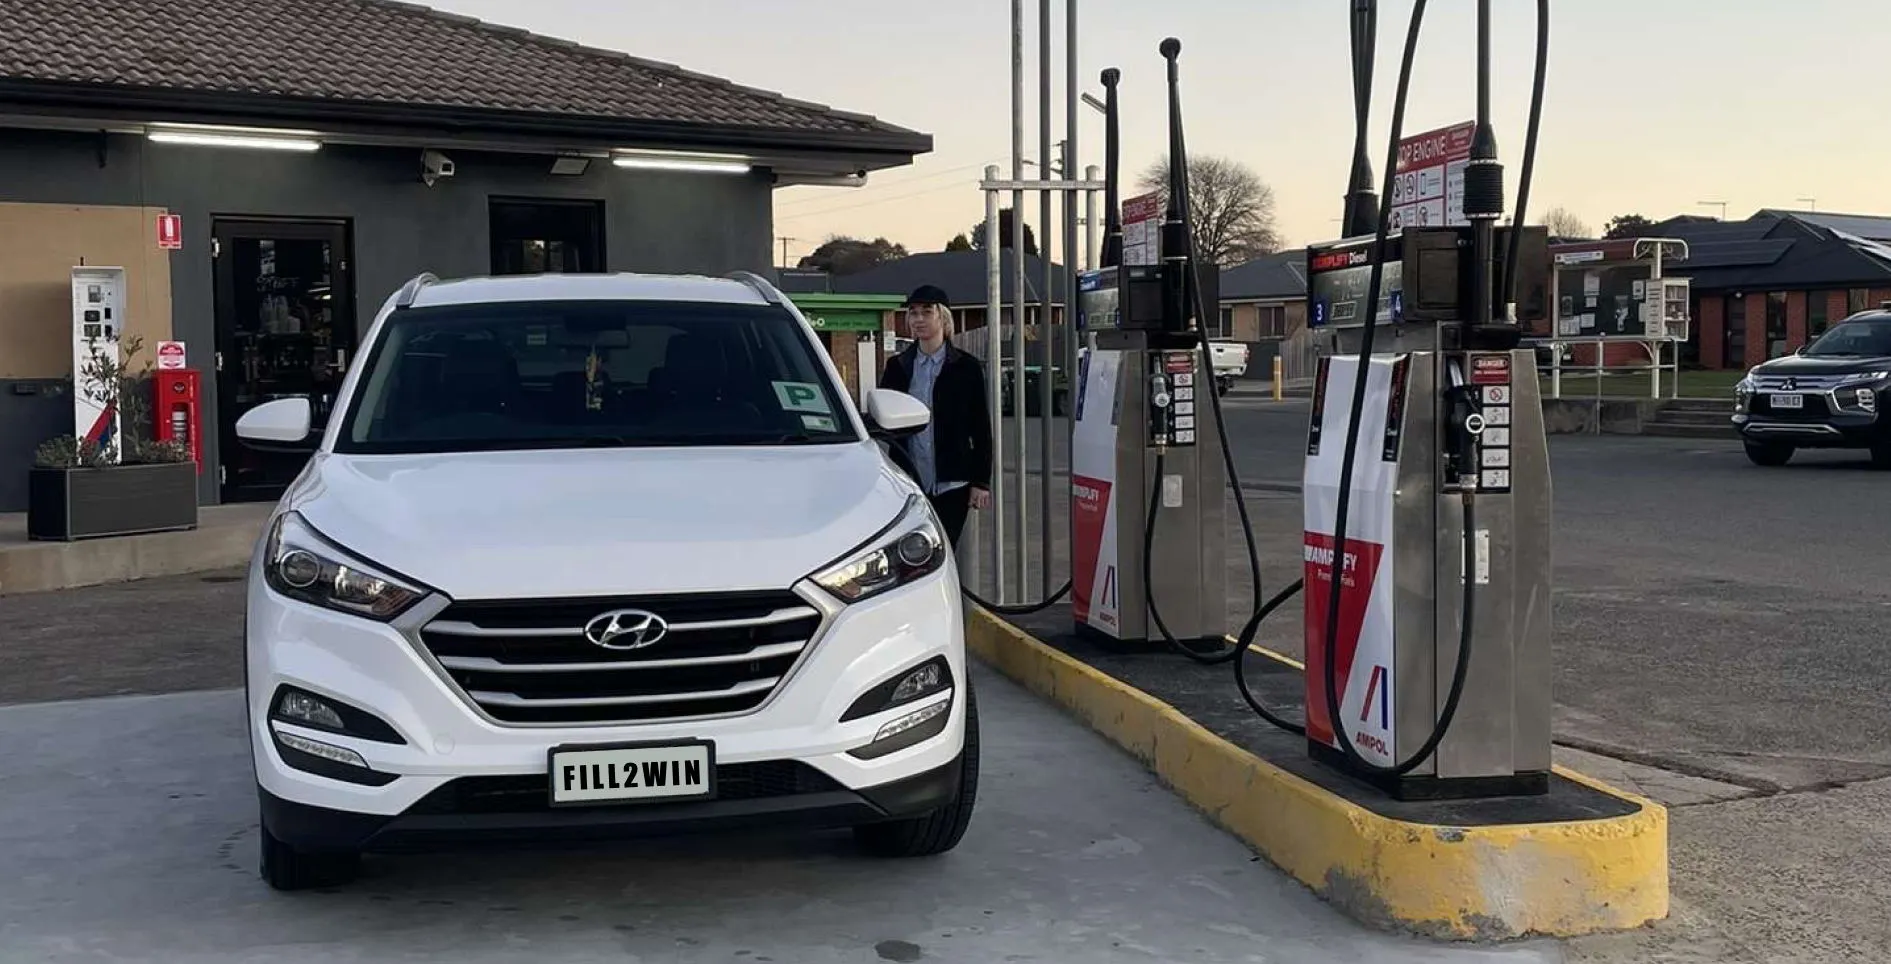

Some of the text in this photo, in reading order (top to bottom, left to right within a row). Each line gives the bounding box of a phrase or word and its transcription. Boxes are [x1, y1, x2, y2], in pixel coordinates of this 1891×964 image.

[1413, 135, 1447, 161] ENGINE
[1316, 303, 1323, 321] 3
[784, 385, 817, 406] P
[1312, 547, 1358, 572] AMPFY
[1355, 731, 1389, 756] AMPOL
[563, 759, 701, 791] FILL2WIN
